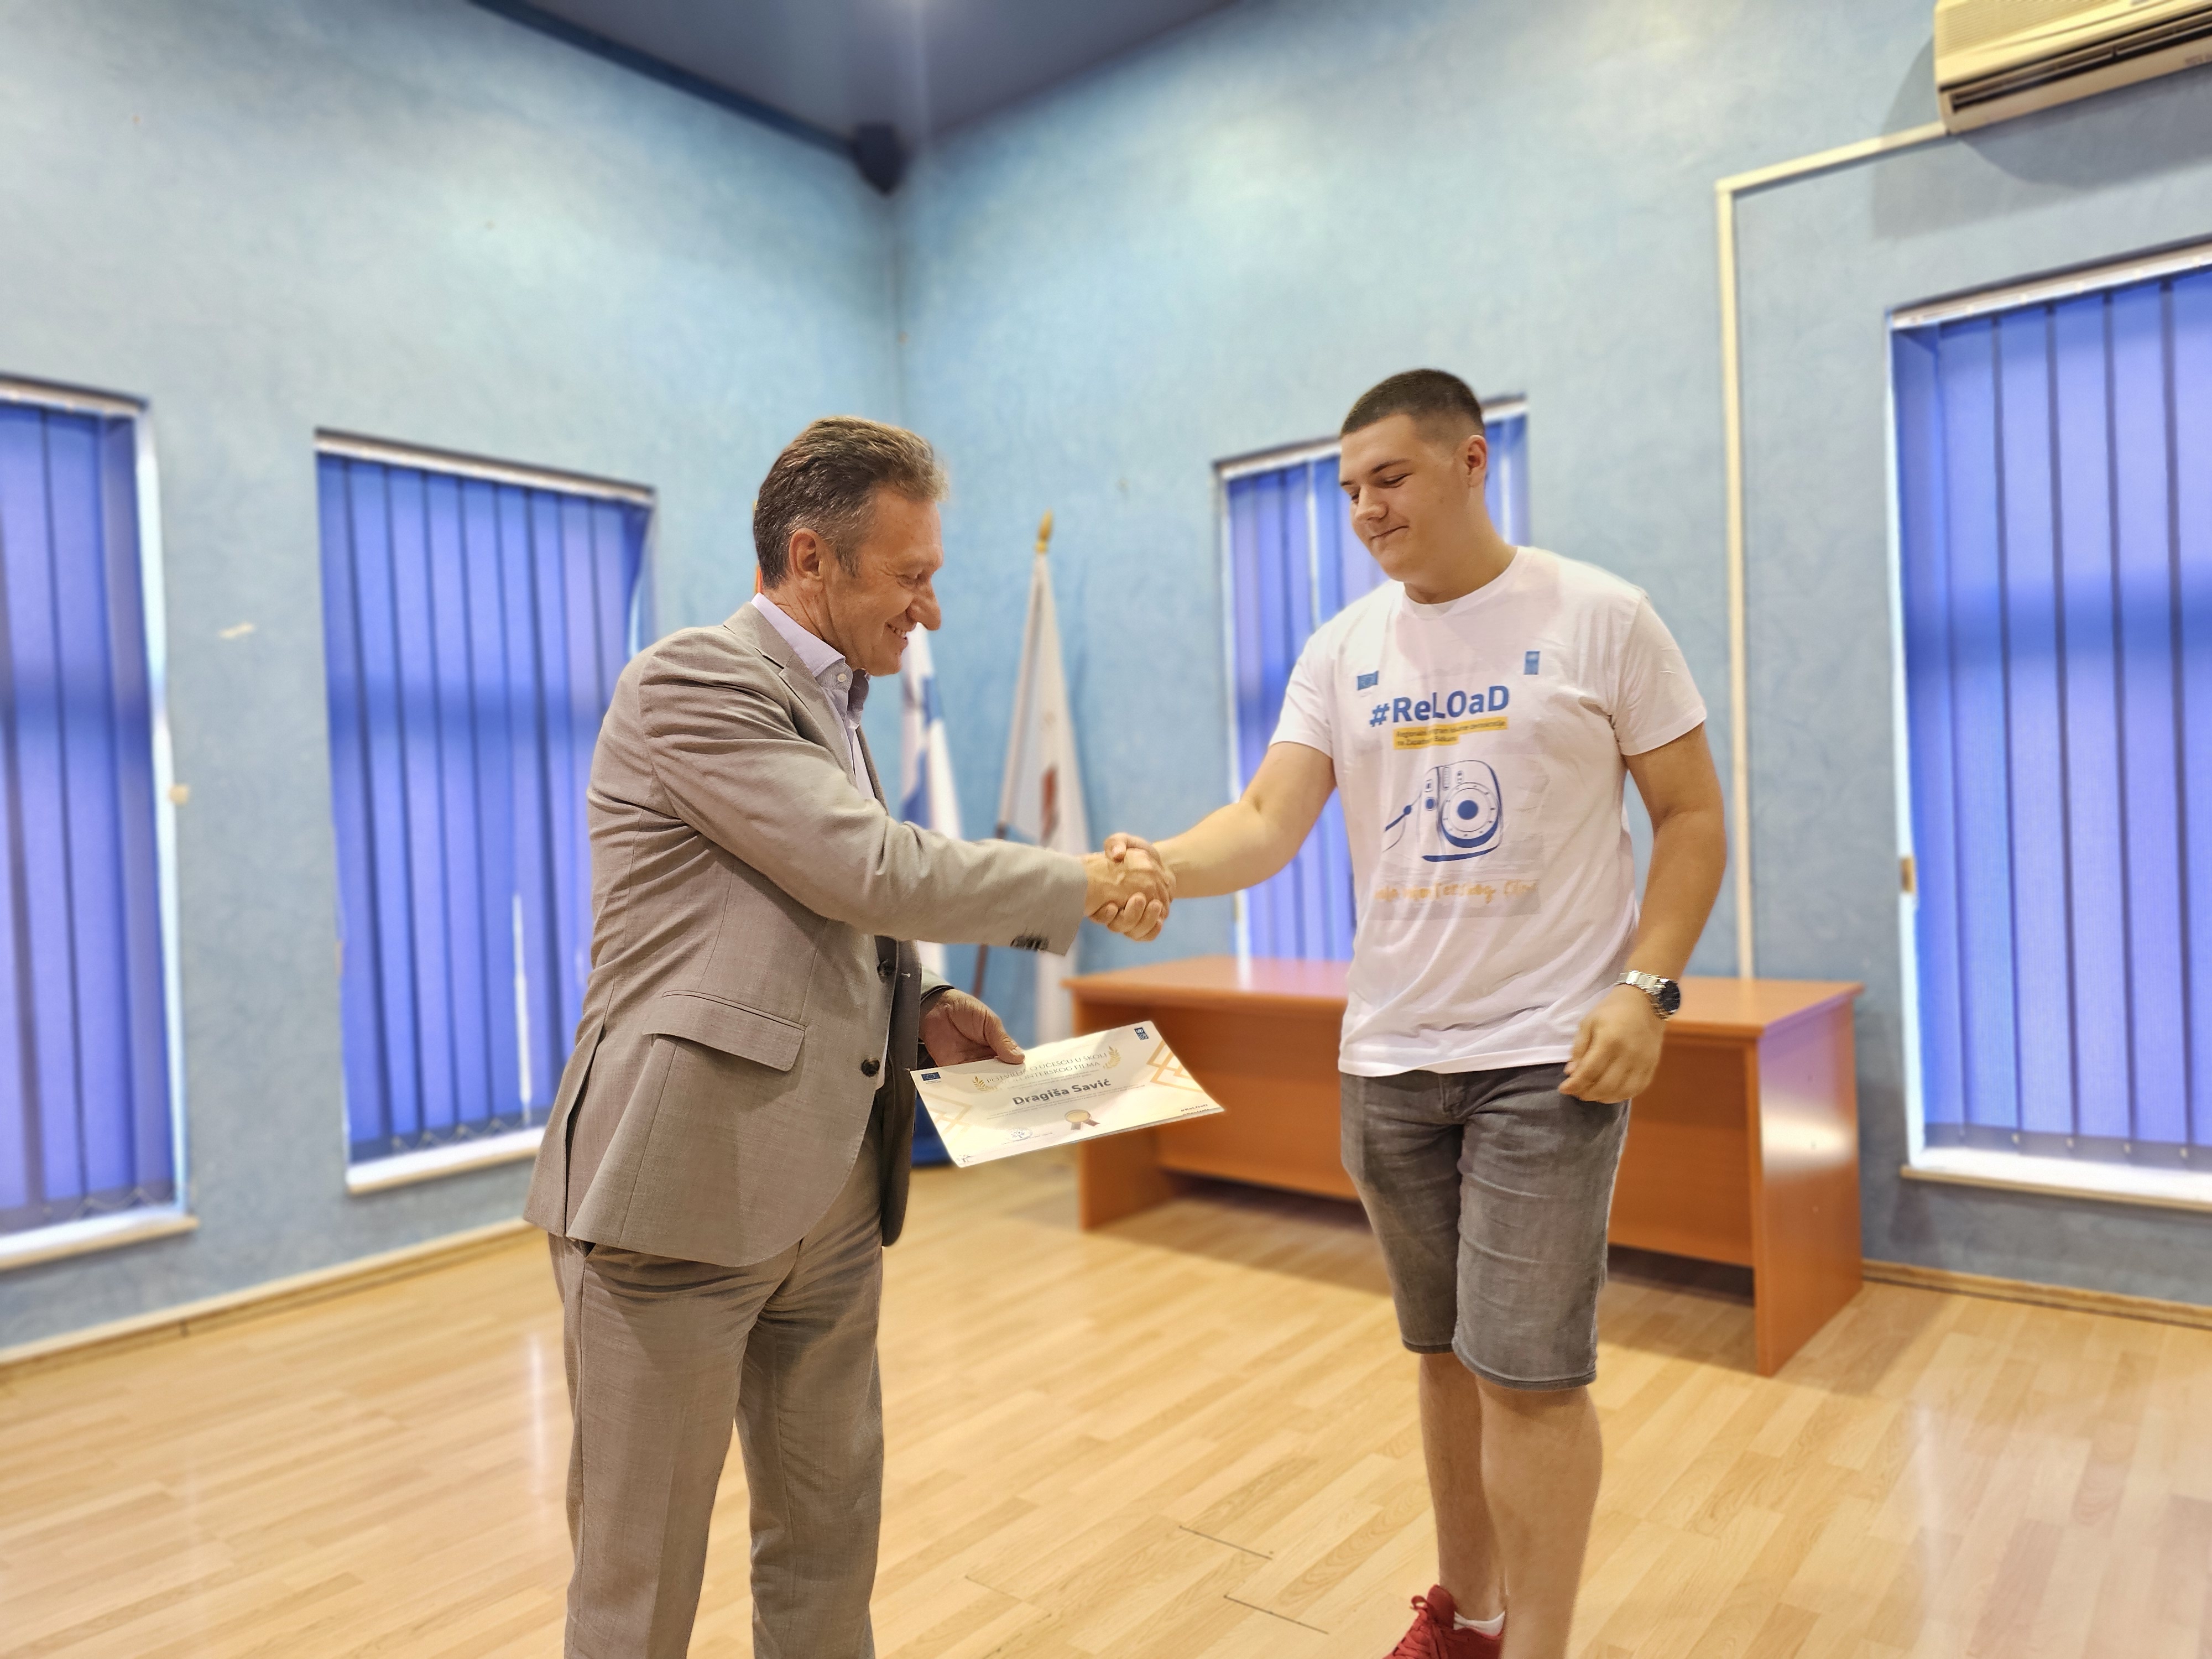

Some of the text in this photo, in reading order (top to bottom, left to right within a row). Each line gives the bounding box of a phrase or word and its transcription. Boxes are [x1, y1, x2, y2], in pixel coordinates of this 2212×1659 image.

[1369, 685, 1510, 727] #ReLOaD
[1001, 1066, 1073, 1083] LONTERSKOG
[1012, 1088, 1070, 1105] Dragiša
[1071, 1078, 1112, 1093] Savić
